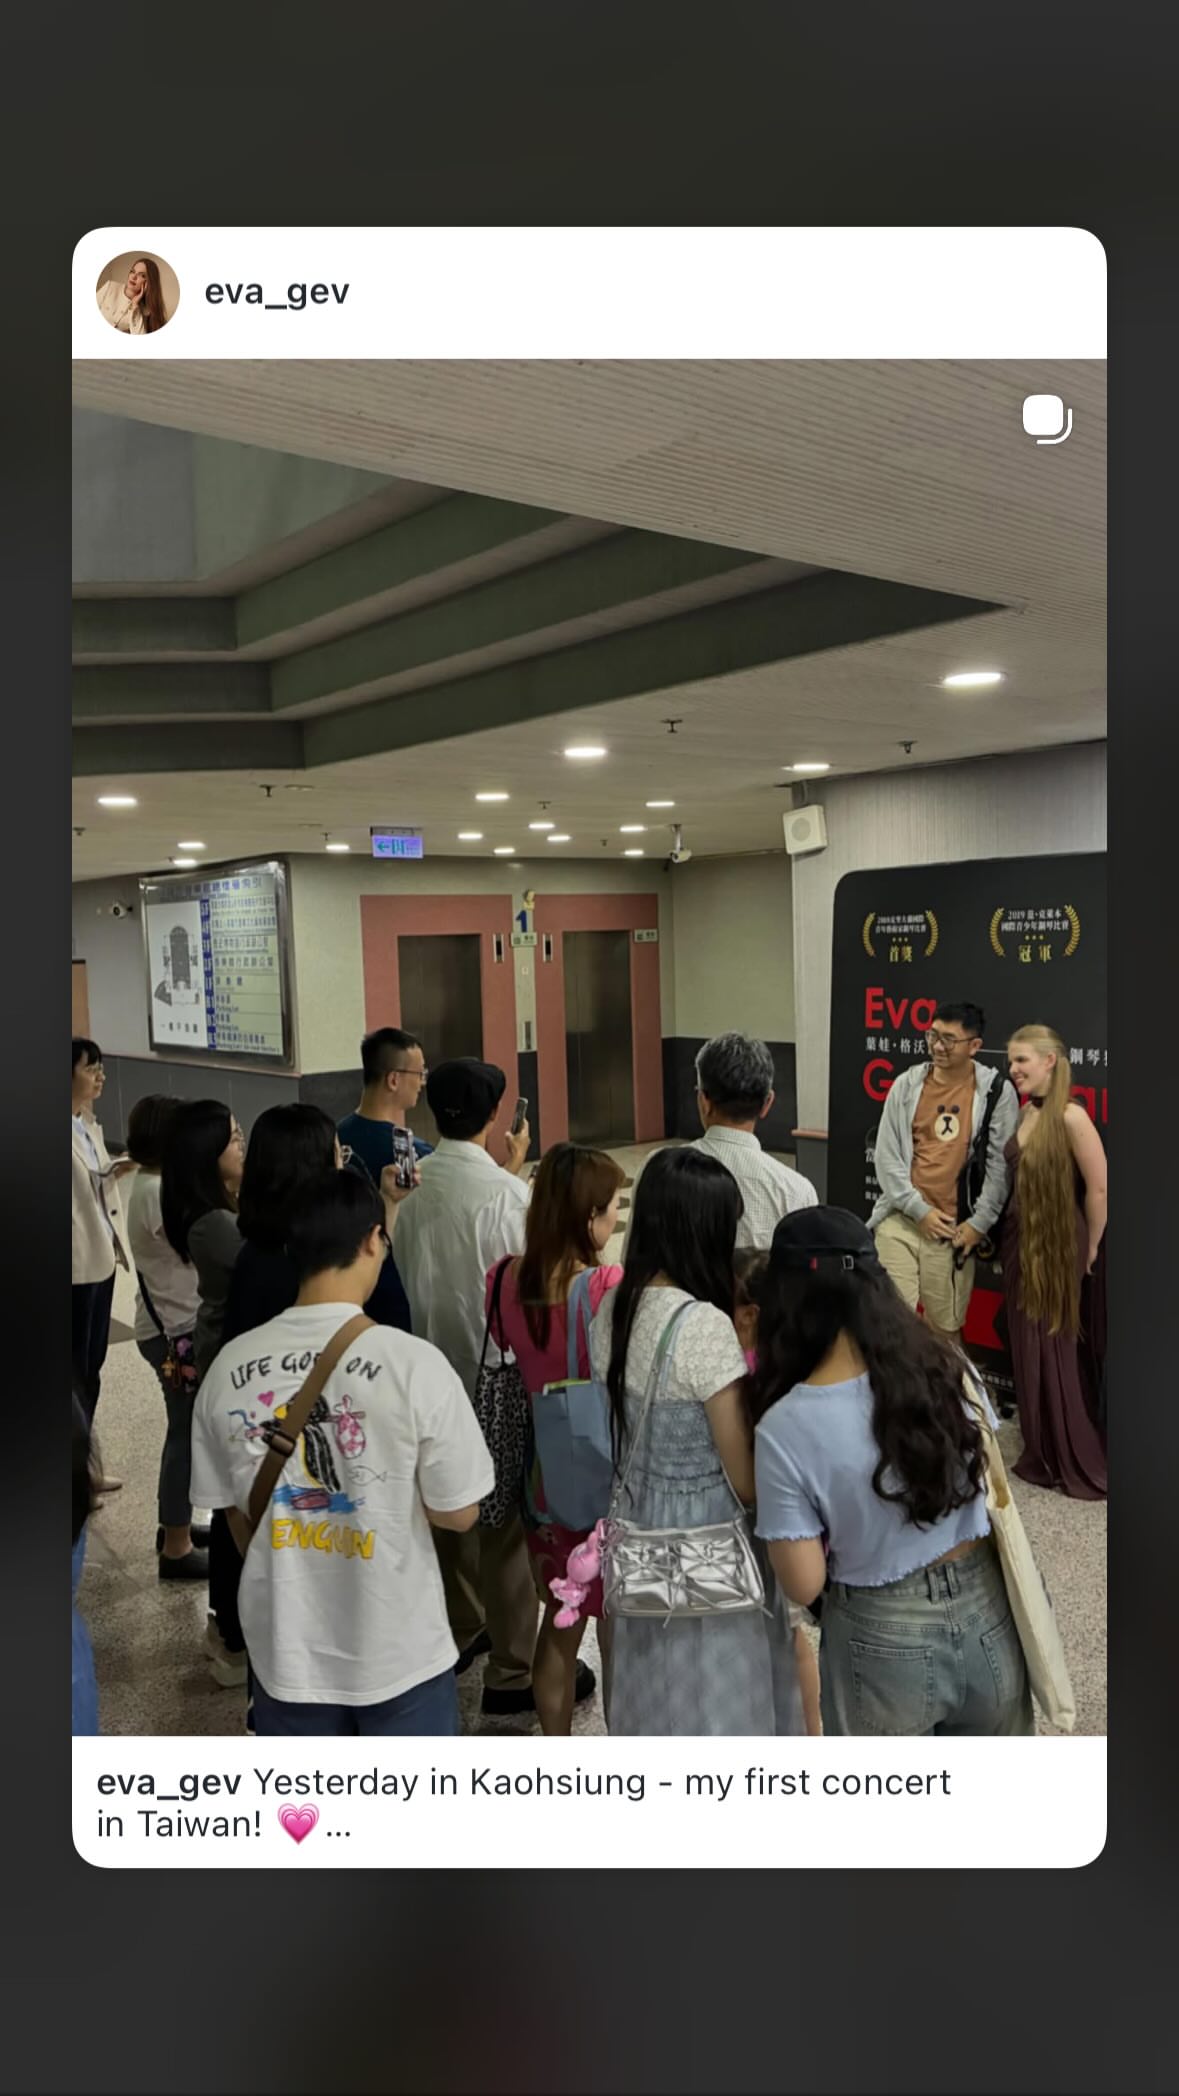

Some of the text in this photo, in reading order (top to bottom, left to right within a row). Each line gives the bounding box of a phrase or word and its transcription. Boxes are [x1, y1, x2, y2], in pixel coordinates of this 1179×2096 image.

[515, 910, 527, 933] 1
[864, 986, 938, 1031] Eva
[866, 1036, 926, 1054] 葉娃·格沃
[230, 1351, 382, 1390] LIFE GO ON
[271, 1518, 377, 1560] ENGUIN
